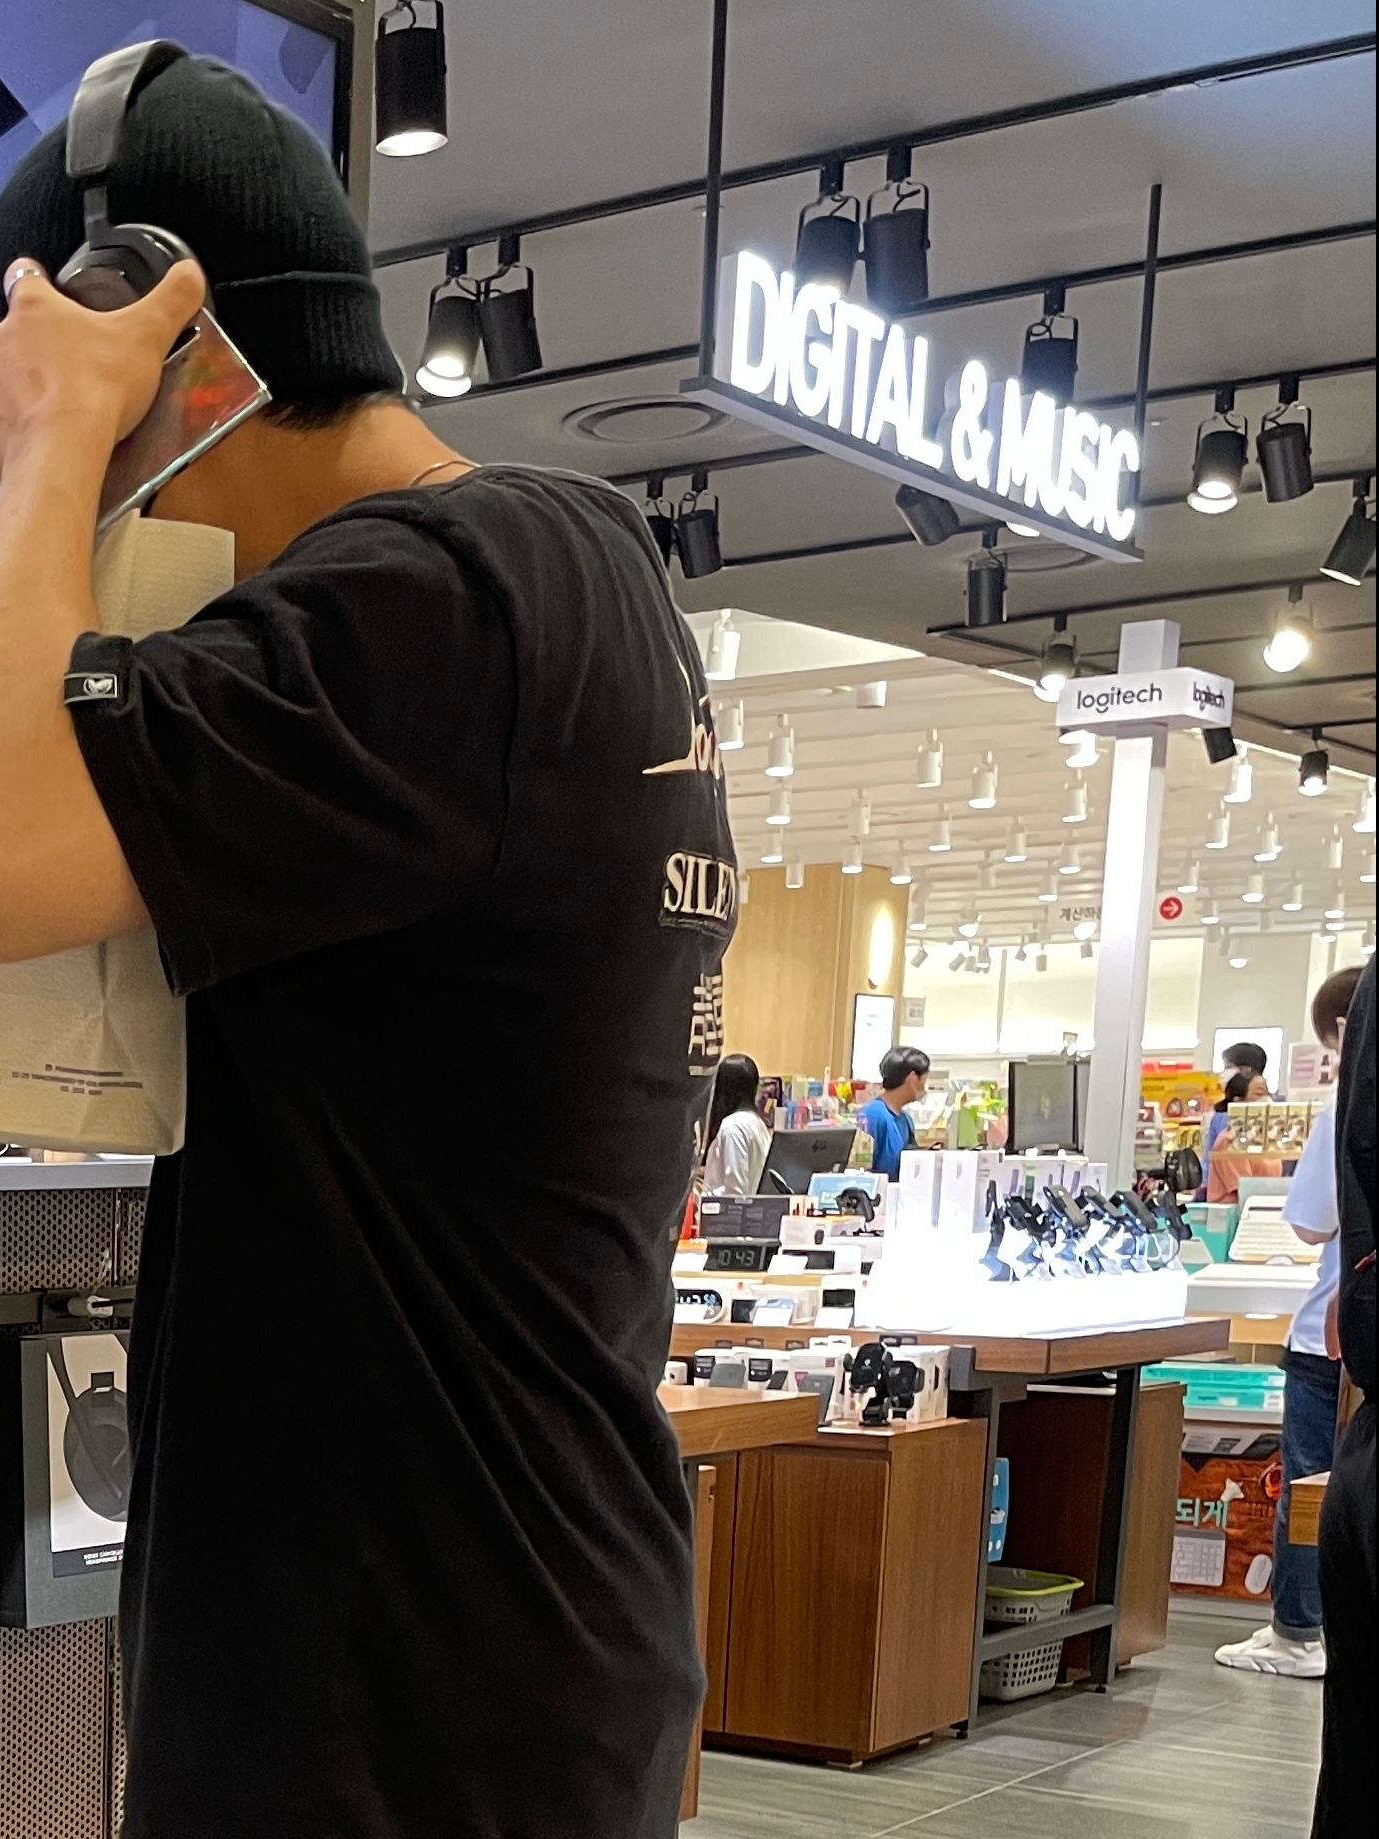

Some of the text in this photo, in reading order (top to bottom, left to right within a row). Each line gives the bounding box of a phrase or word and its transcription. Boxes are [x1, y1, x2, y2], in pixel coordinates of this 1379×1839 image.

[730, 250, 1140, 541] DIGITAL & MUSIC
[1077, 683, 1163, 713] logitech
